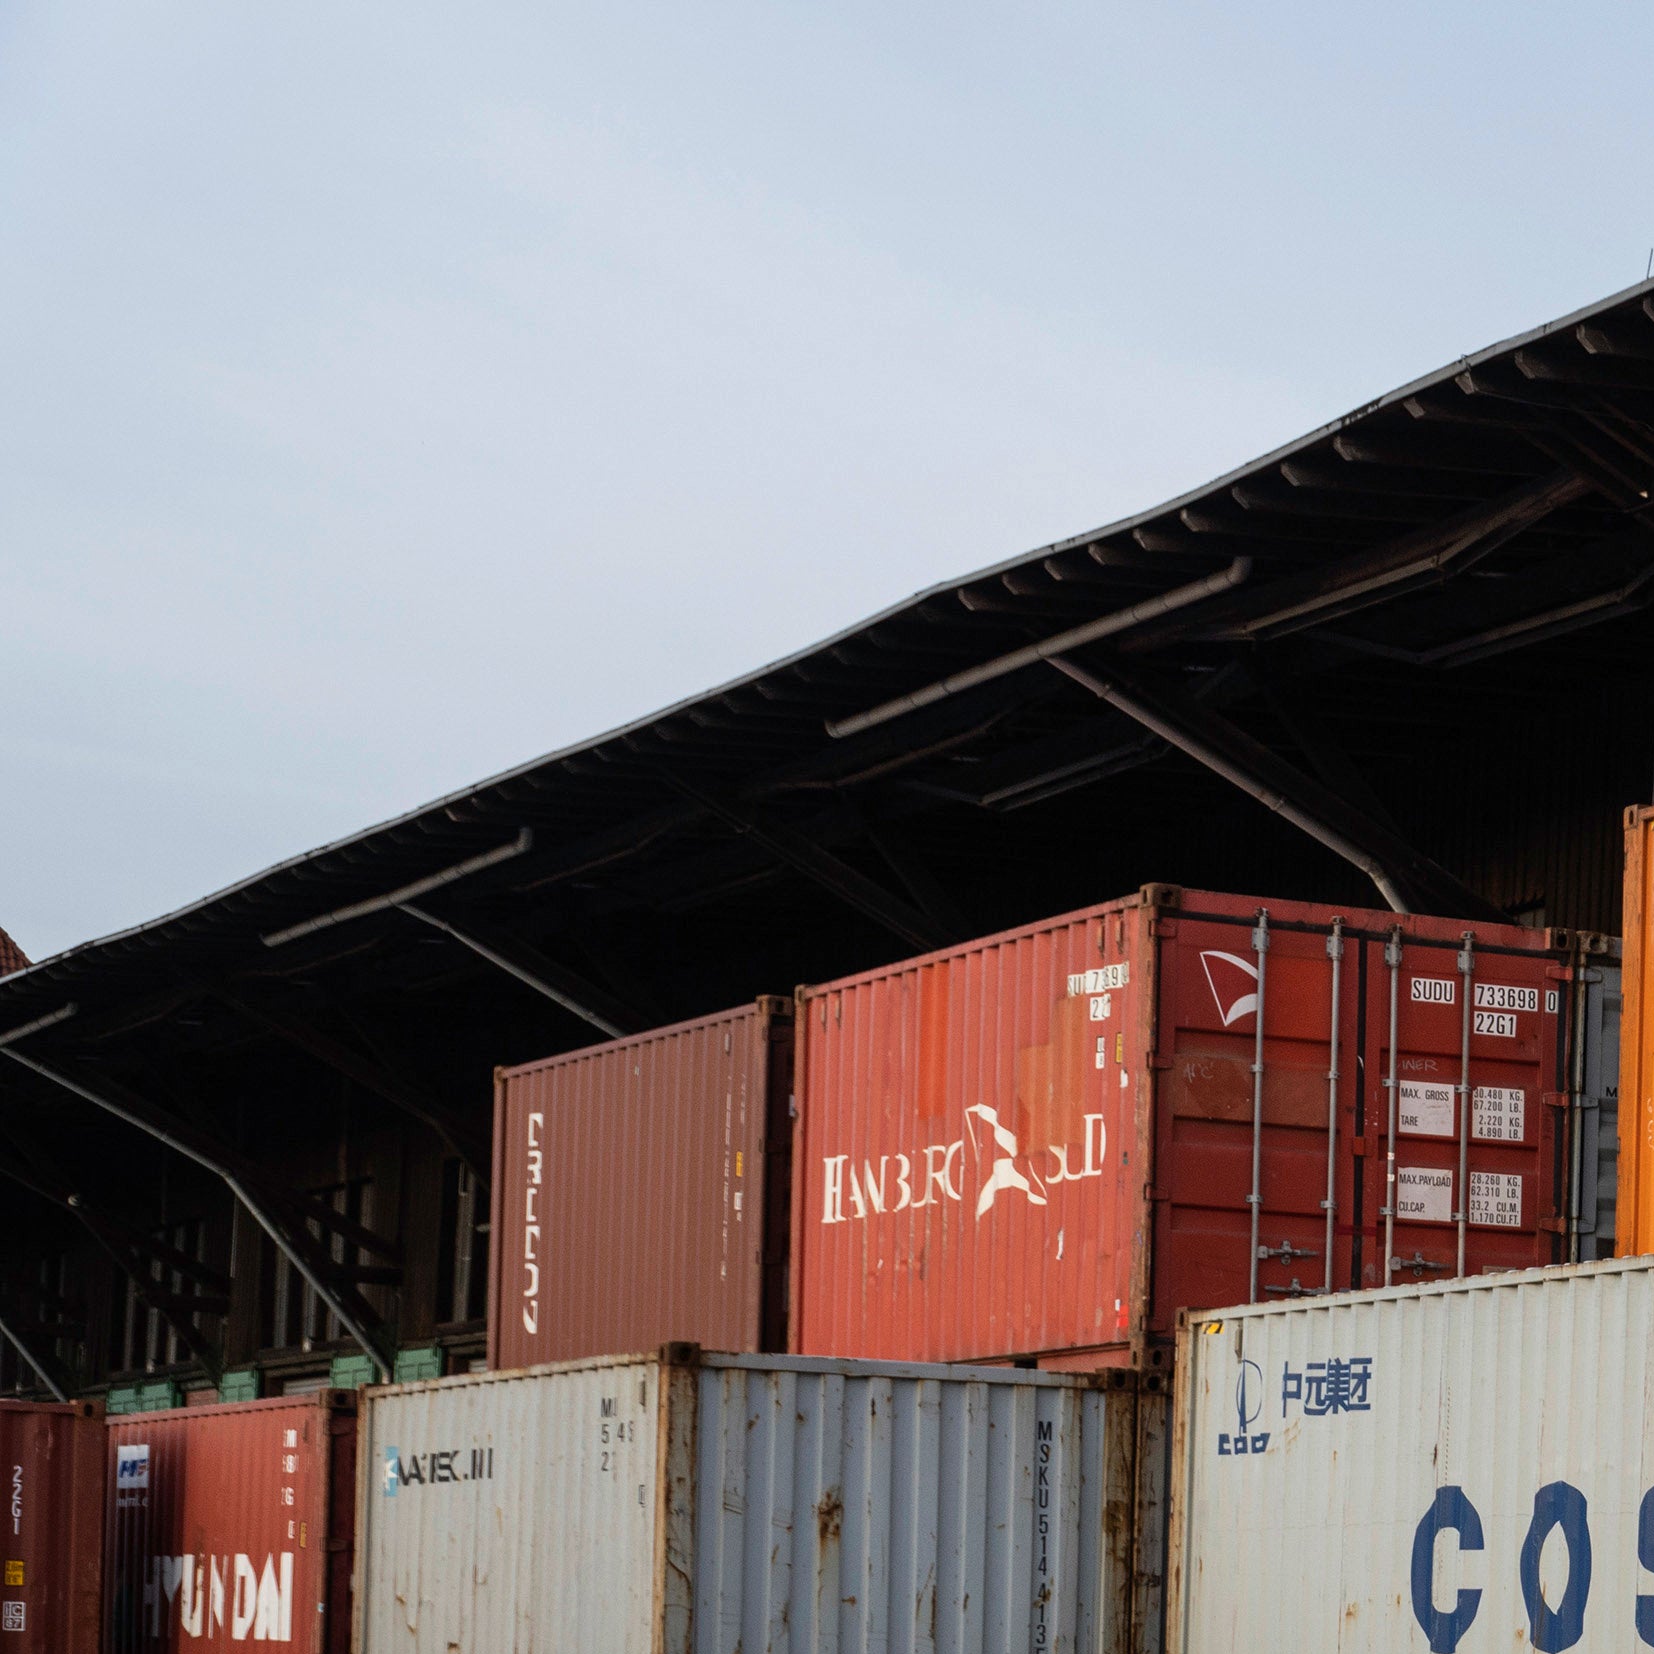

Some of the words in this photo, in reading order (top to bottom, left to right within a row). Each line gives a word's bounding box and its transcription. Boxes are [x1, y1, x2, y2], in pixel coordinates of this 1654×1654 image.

[1412, 980, 1453, 1002] SUDU
[1476, 985, 1536, 1010] 733698
[1475, 1013, 1514, 1036] 22G1
[1401, 1087, 1421, 1100] MAX.
[1425, 1090, 1450, 1102] GROSS
[1473, 1088, 1503, 1100] 30.480
[1509, 1090, 1523, 1102] KG.
[1473, 1100, 1503, 1112] 67.200
[1509, 1102, 1522, 1113] LB.
[1401, 1114, 1419, 1126] TARE
[1479, 1114, 1503, 1126] 2.220
[1509, 1116, 1523, 1128] KG.
[1478, 1127, 1502, 1138] 4.890
[1508, 1129, 1521, 1140] LB.
[1471, 1174, 1501, 1186] 28.260
[1507, 1175, 1521, 1188] KG.
[1471, 1186, 1501, 1198] 62.310
[1506, 1187, 1519, 1199] LB.
[1470, 1200, 1490, 1212] 33.2
[1038, 1421, 1052, 1508] MSKU
[11, 1465, 24, 1535] 22G1
